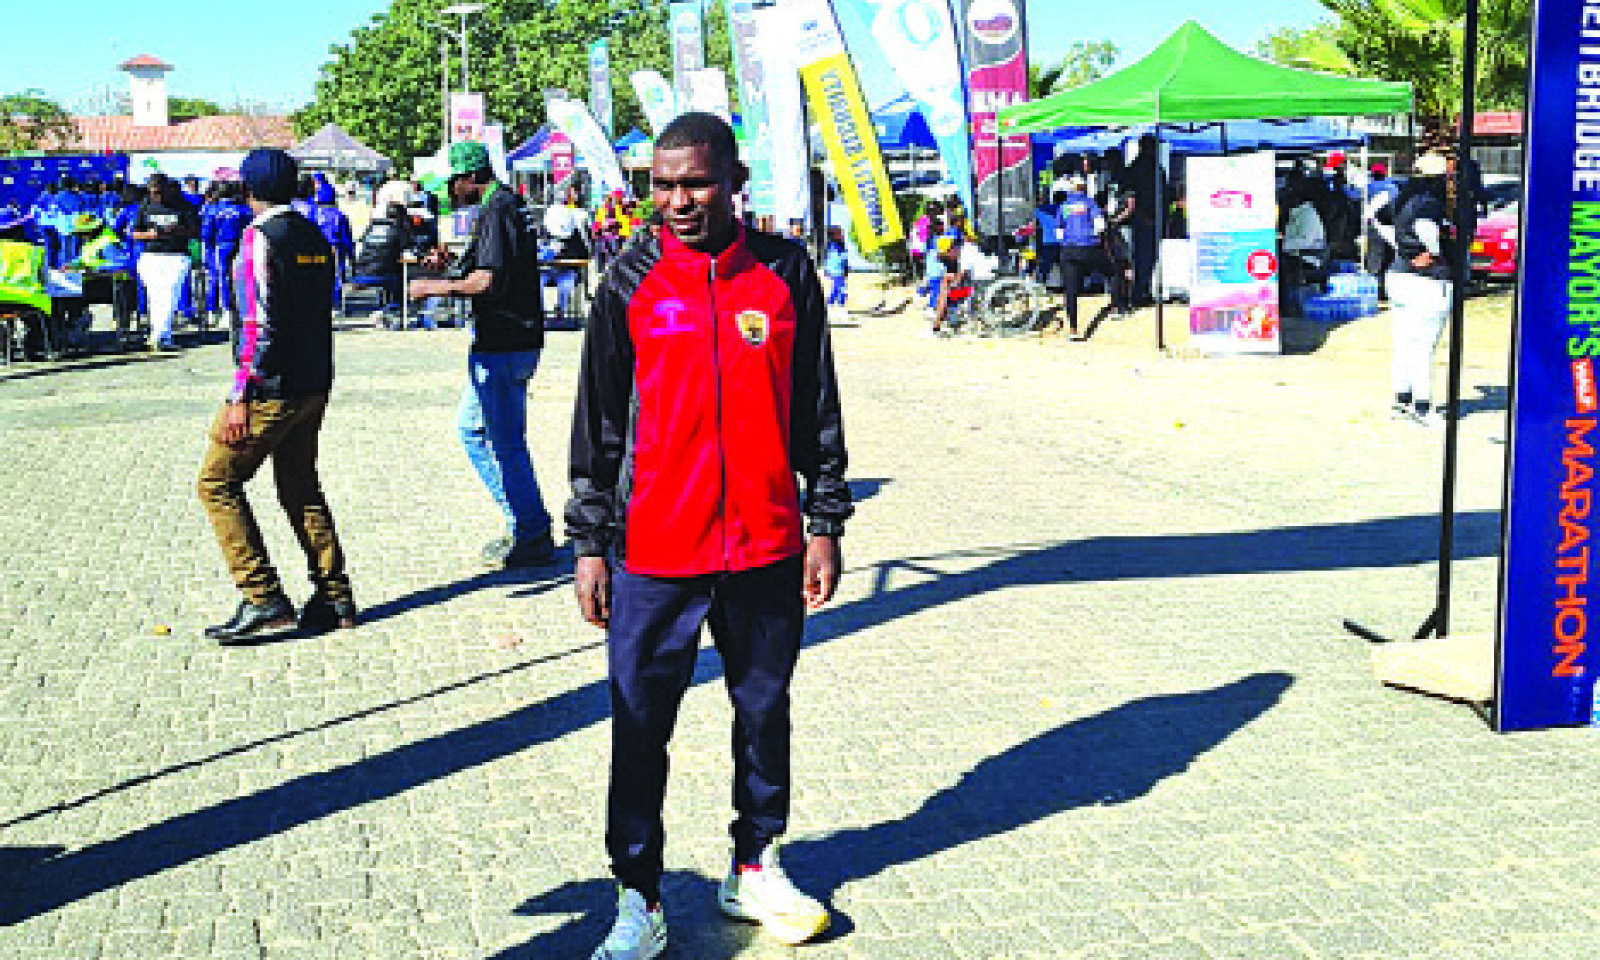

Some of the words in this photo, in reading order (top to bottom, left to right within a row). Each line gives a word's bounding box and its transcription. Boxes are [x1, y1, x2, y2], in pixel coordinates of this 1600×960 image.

[1572, 0, 1600, 191] EITBRIDGE
[1567, 201, 1600, 357] MAYOR'S
[1552, 419, 1598, 677] MARATHON
